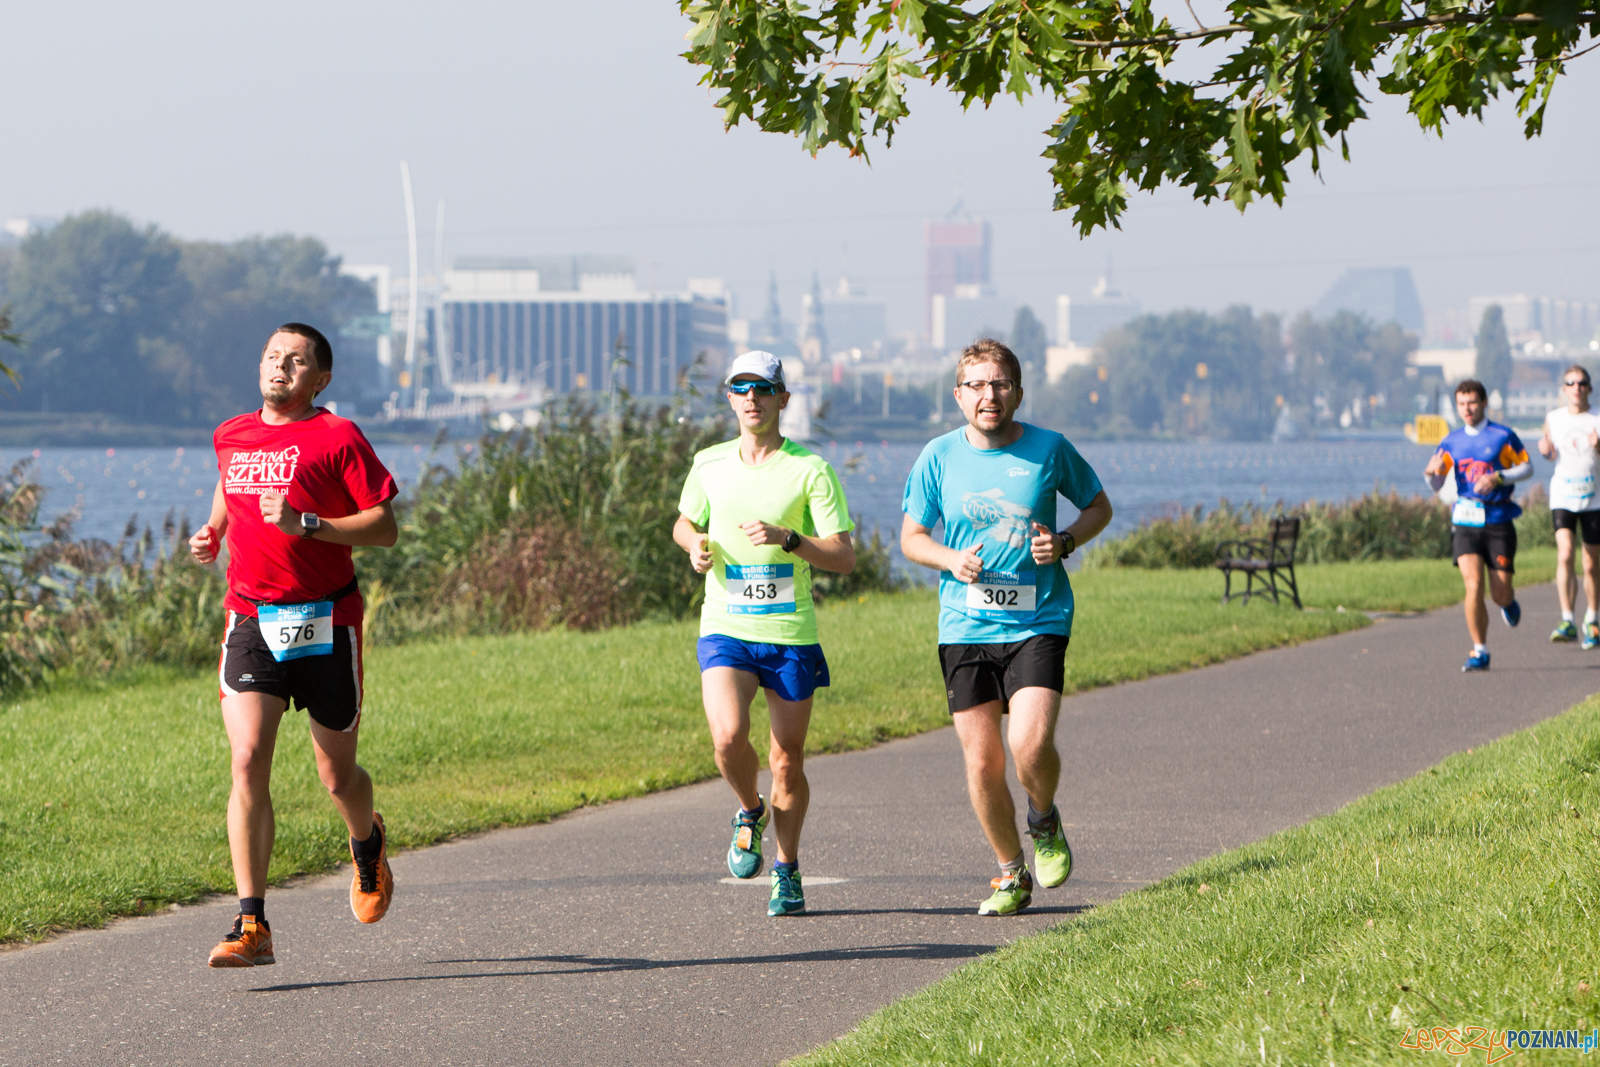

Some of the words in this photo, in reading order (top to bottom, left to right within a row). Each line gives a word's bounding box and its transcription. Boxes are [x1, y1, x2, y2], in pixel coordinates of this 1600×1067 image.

[230, 449, 284, 464] DRUŻYNA
[225, 462, 297, 484] SZPIKU
[984, 571, 1020, 580] zaBIEGaj
[743, 583, 777, 600] 453
[983, 588, 1018, 606] 302
[279, 623, 314, 644] 576
